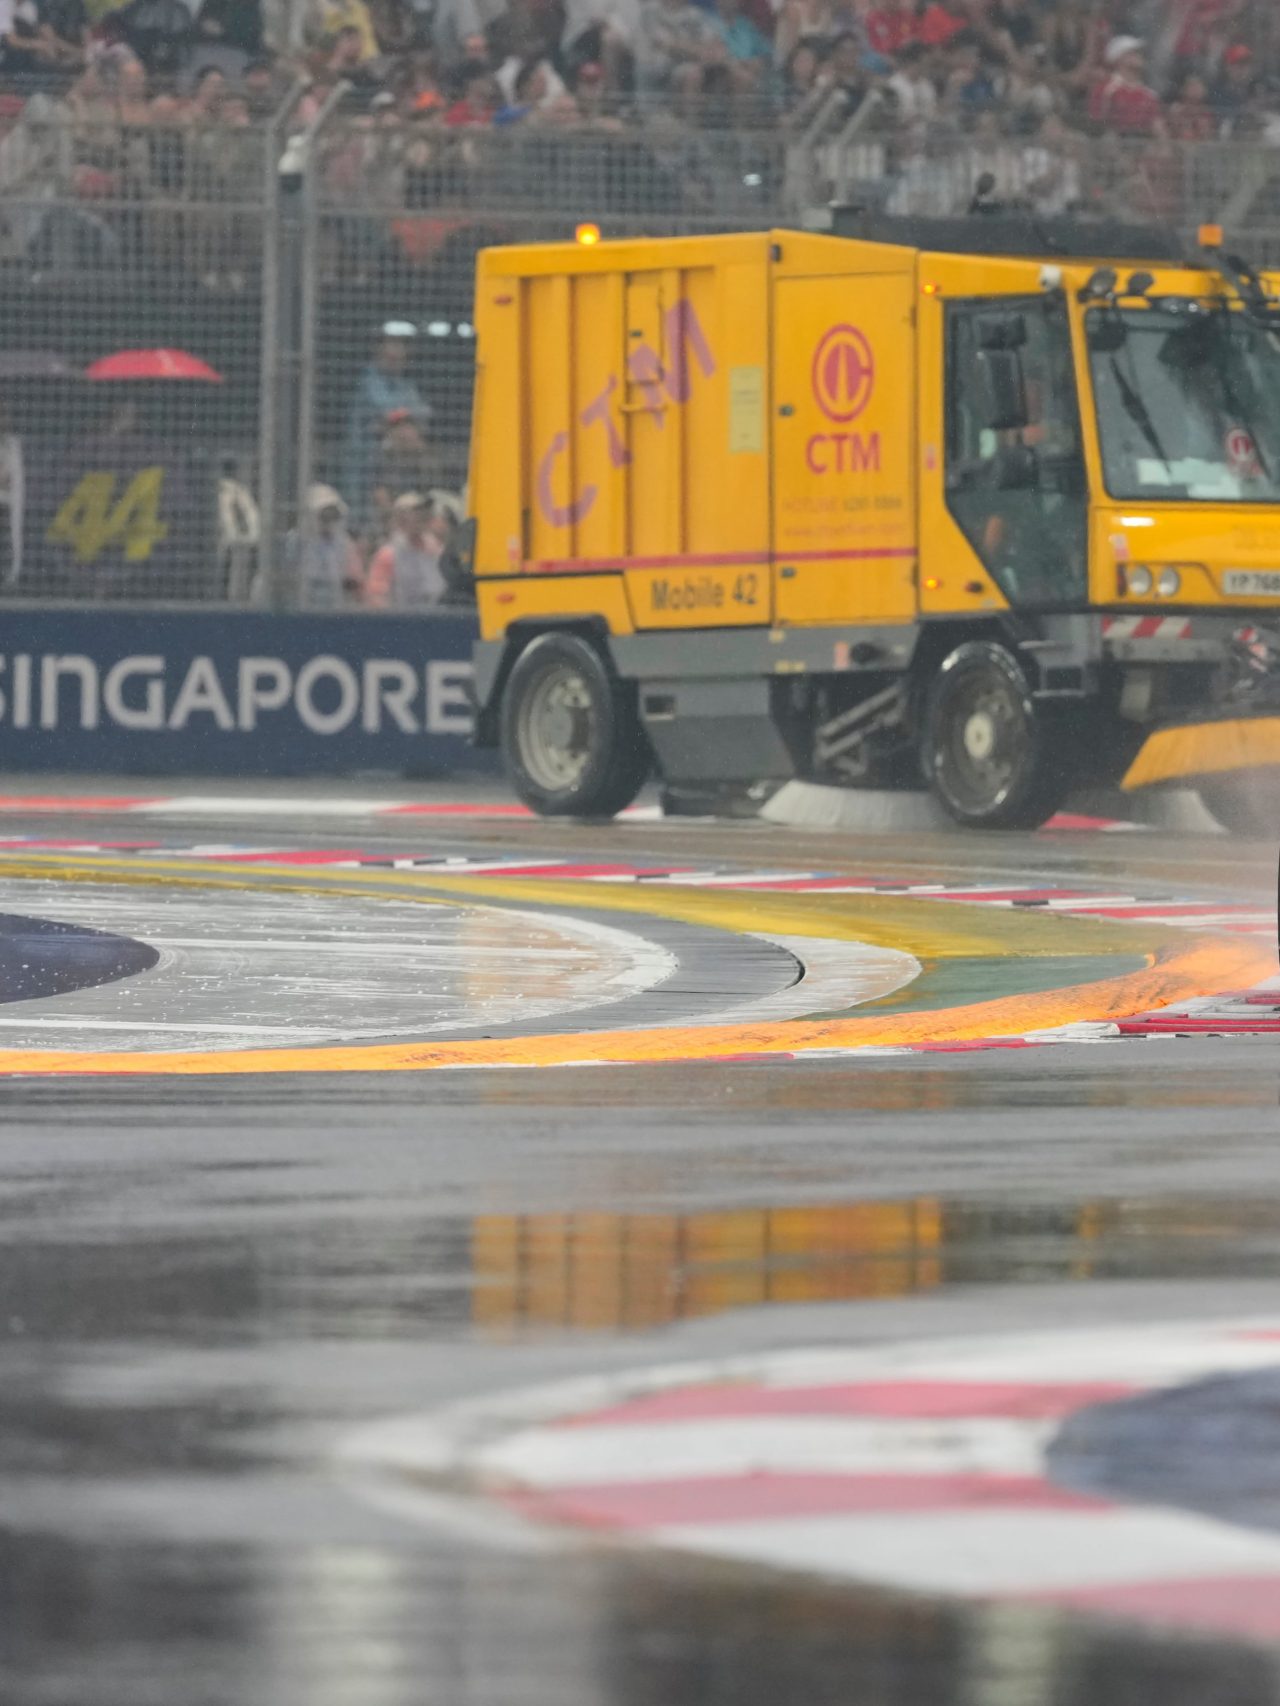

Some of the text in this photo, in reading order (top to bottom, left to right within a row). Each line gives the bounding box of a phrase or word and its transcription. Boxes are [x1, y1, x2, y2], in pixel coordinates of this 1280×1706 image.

[806, 431, 881, 476] CTM
[47, 467, 167, 564] 44
[732, 572, 758, 606] 42
[0, 654, 473, 734] INGAPORE
